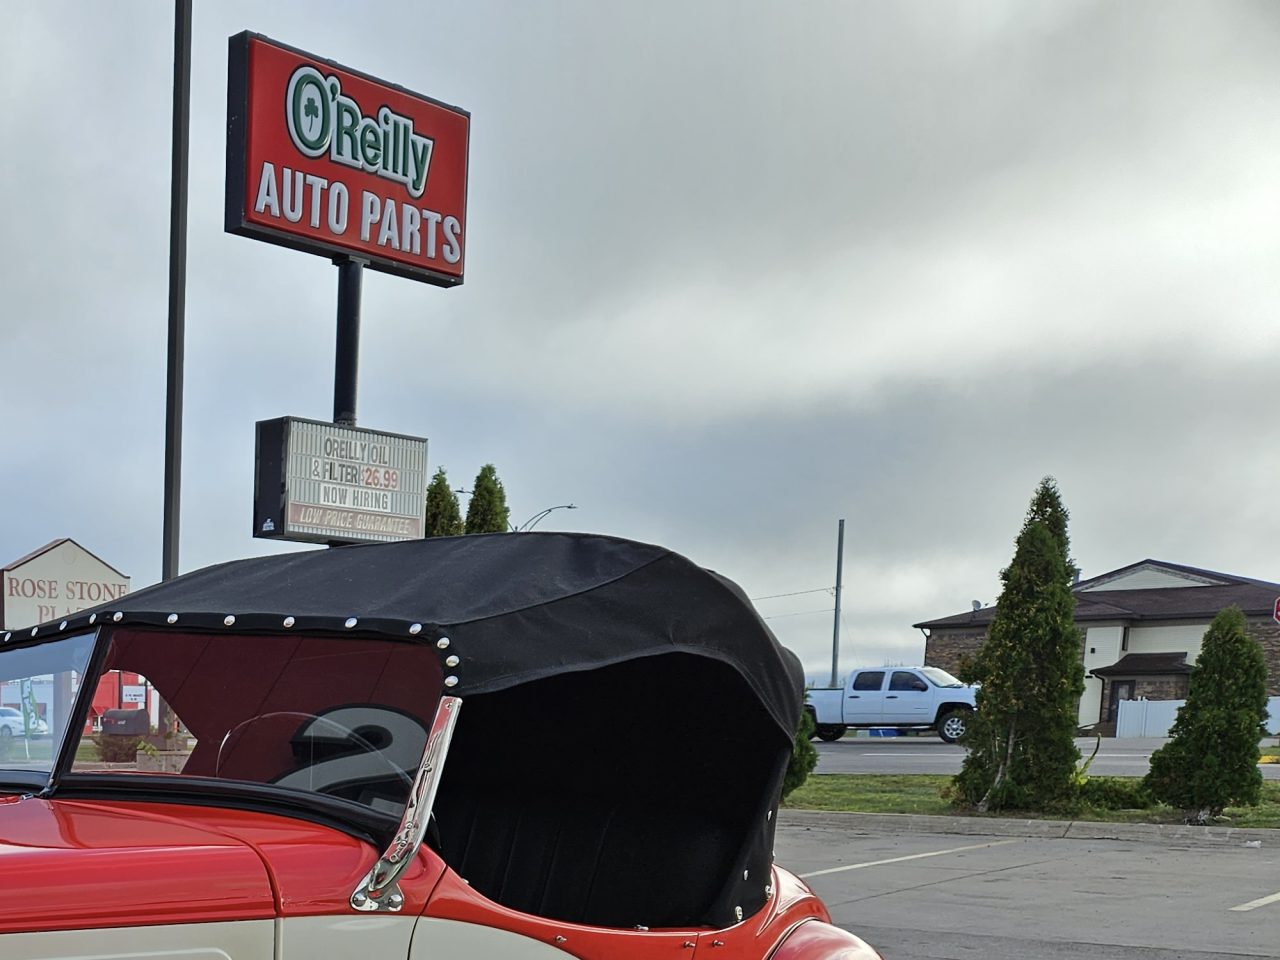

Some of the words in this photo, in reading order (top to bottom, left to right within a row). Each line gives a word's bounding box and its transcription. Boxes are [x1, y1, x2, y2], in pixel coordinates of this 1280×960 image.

[287, 66, 433, 197] O'Reilly
[254, 161, 349, 235] AUTO
[360, 191, 462, 264] PARTS
[324, 437, 367, 462] OREILLY
[370, 445, 388, 465] OIL
[312, 461, 321, 479] &
[323, 462, 358, 484] FILTER
[323, 486, 348, 506] NOW
[352, 490, 389, 510] HIRING
[300, 507, 322, 524] LOW
[324, 510, 353, 529] PRICE
[356, 513, 410, 534] GUARANTEE
[8, 577, 58, 599] ROSE
[66, 581, 127, 602] STONE
